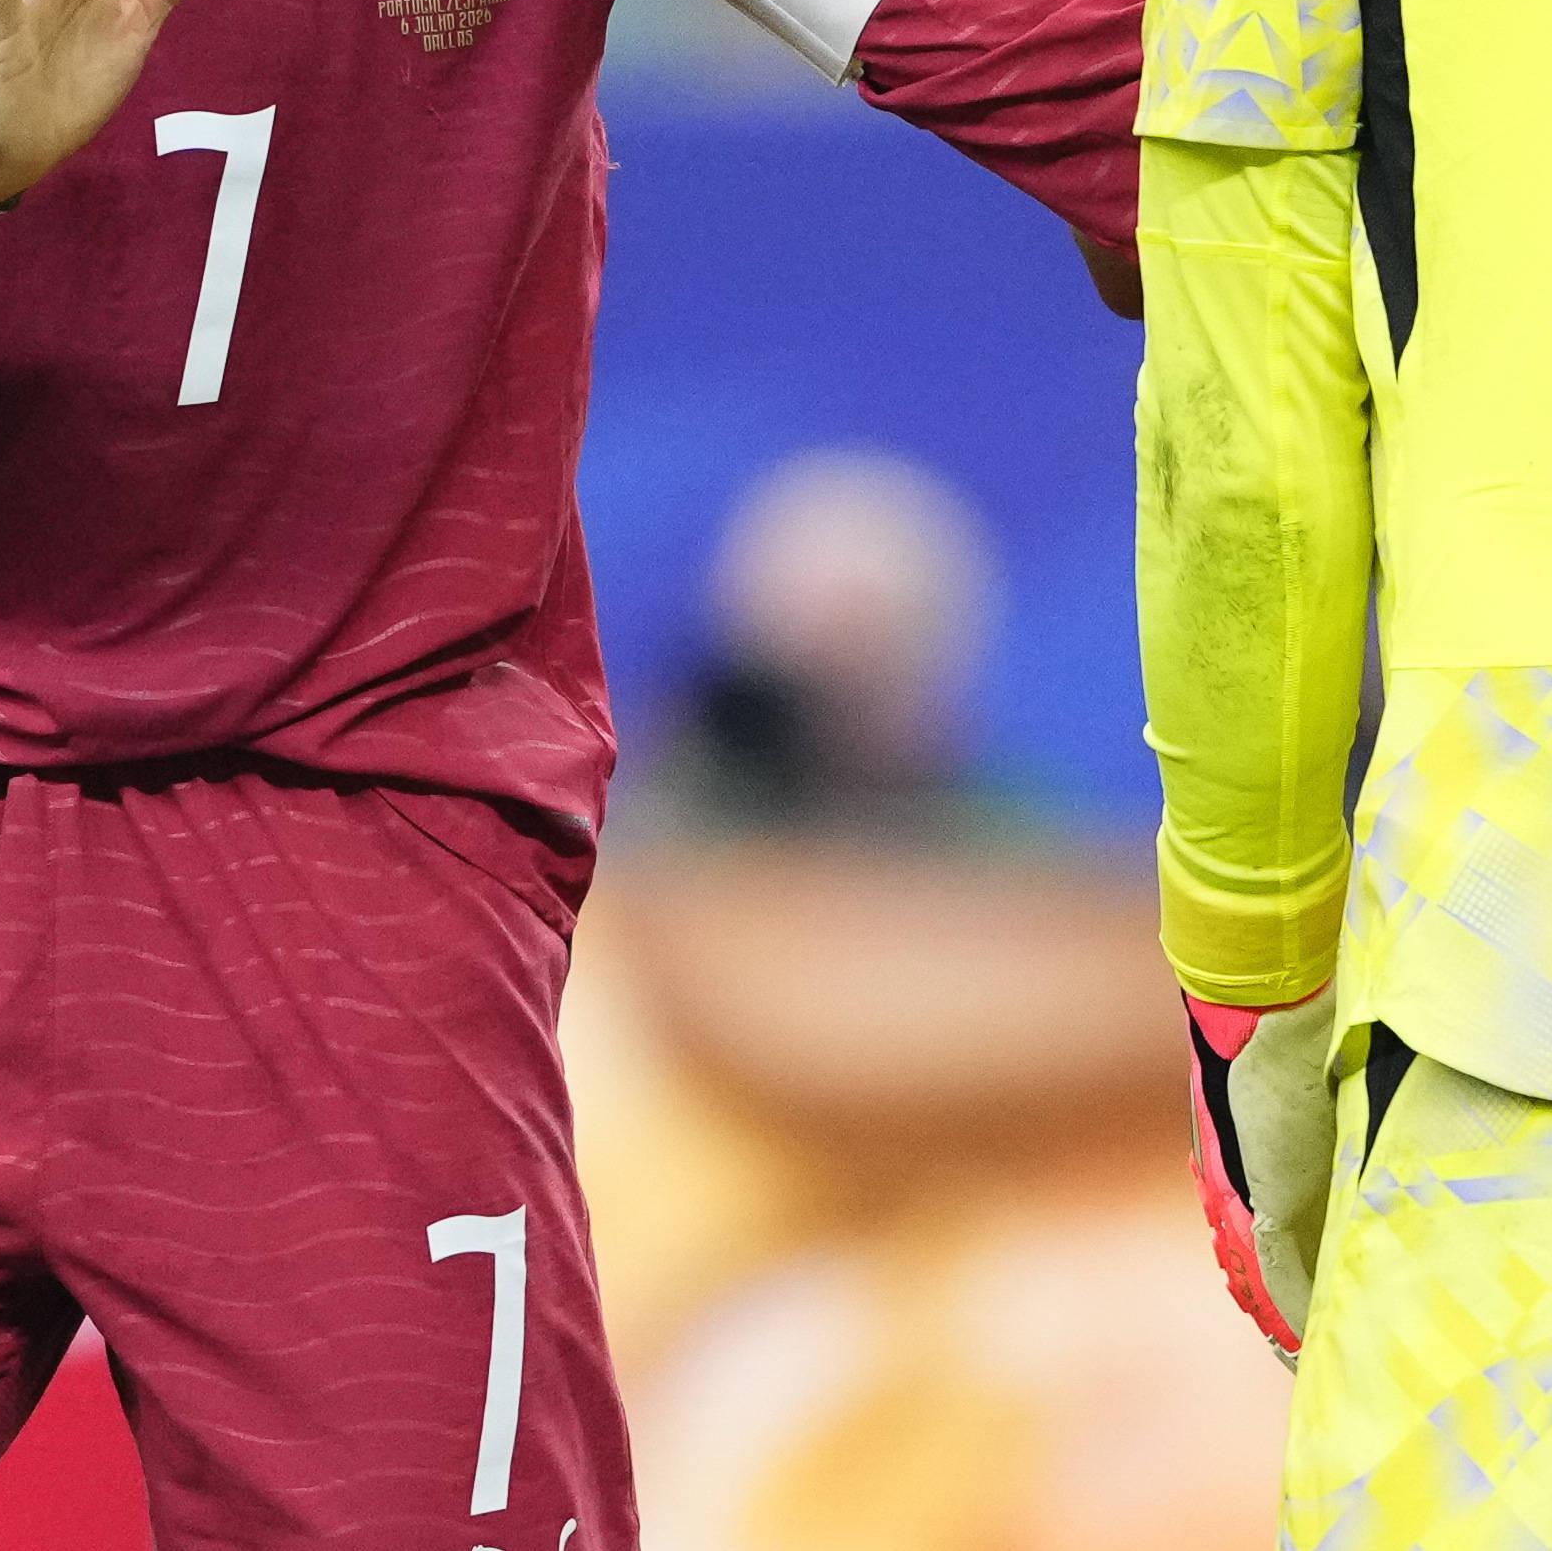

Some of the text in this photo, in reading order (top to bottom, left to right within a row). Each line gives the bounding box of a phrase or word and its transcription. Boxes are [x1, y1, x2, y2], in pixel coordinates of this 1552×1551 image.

[400, 9, 492, 35] 6 JULHO 2026
[423, 30, 474, 53] DALLAS
[154, 104, 277, 407] 7
[425, 1203, 528, 1517] 7
